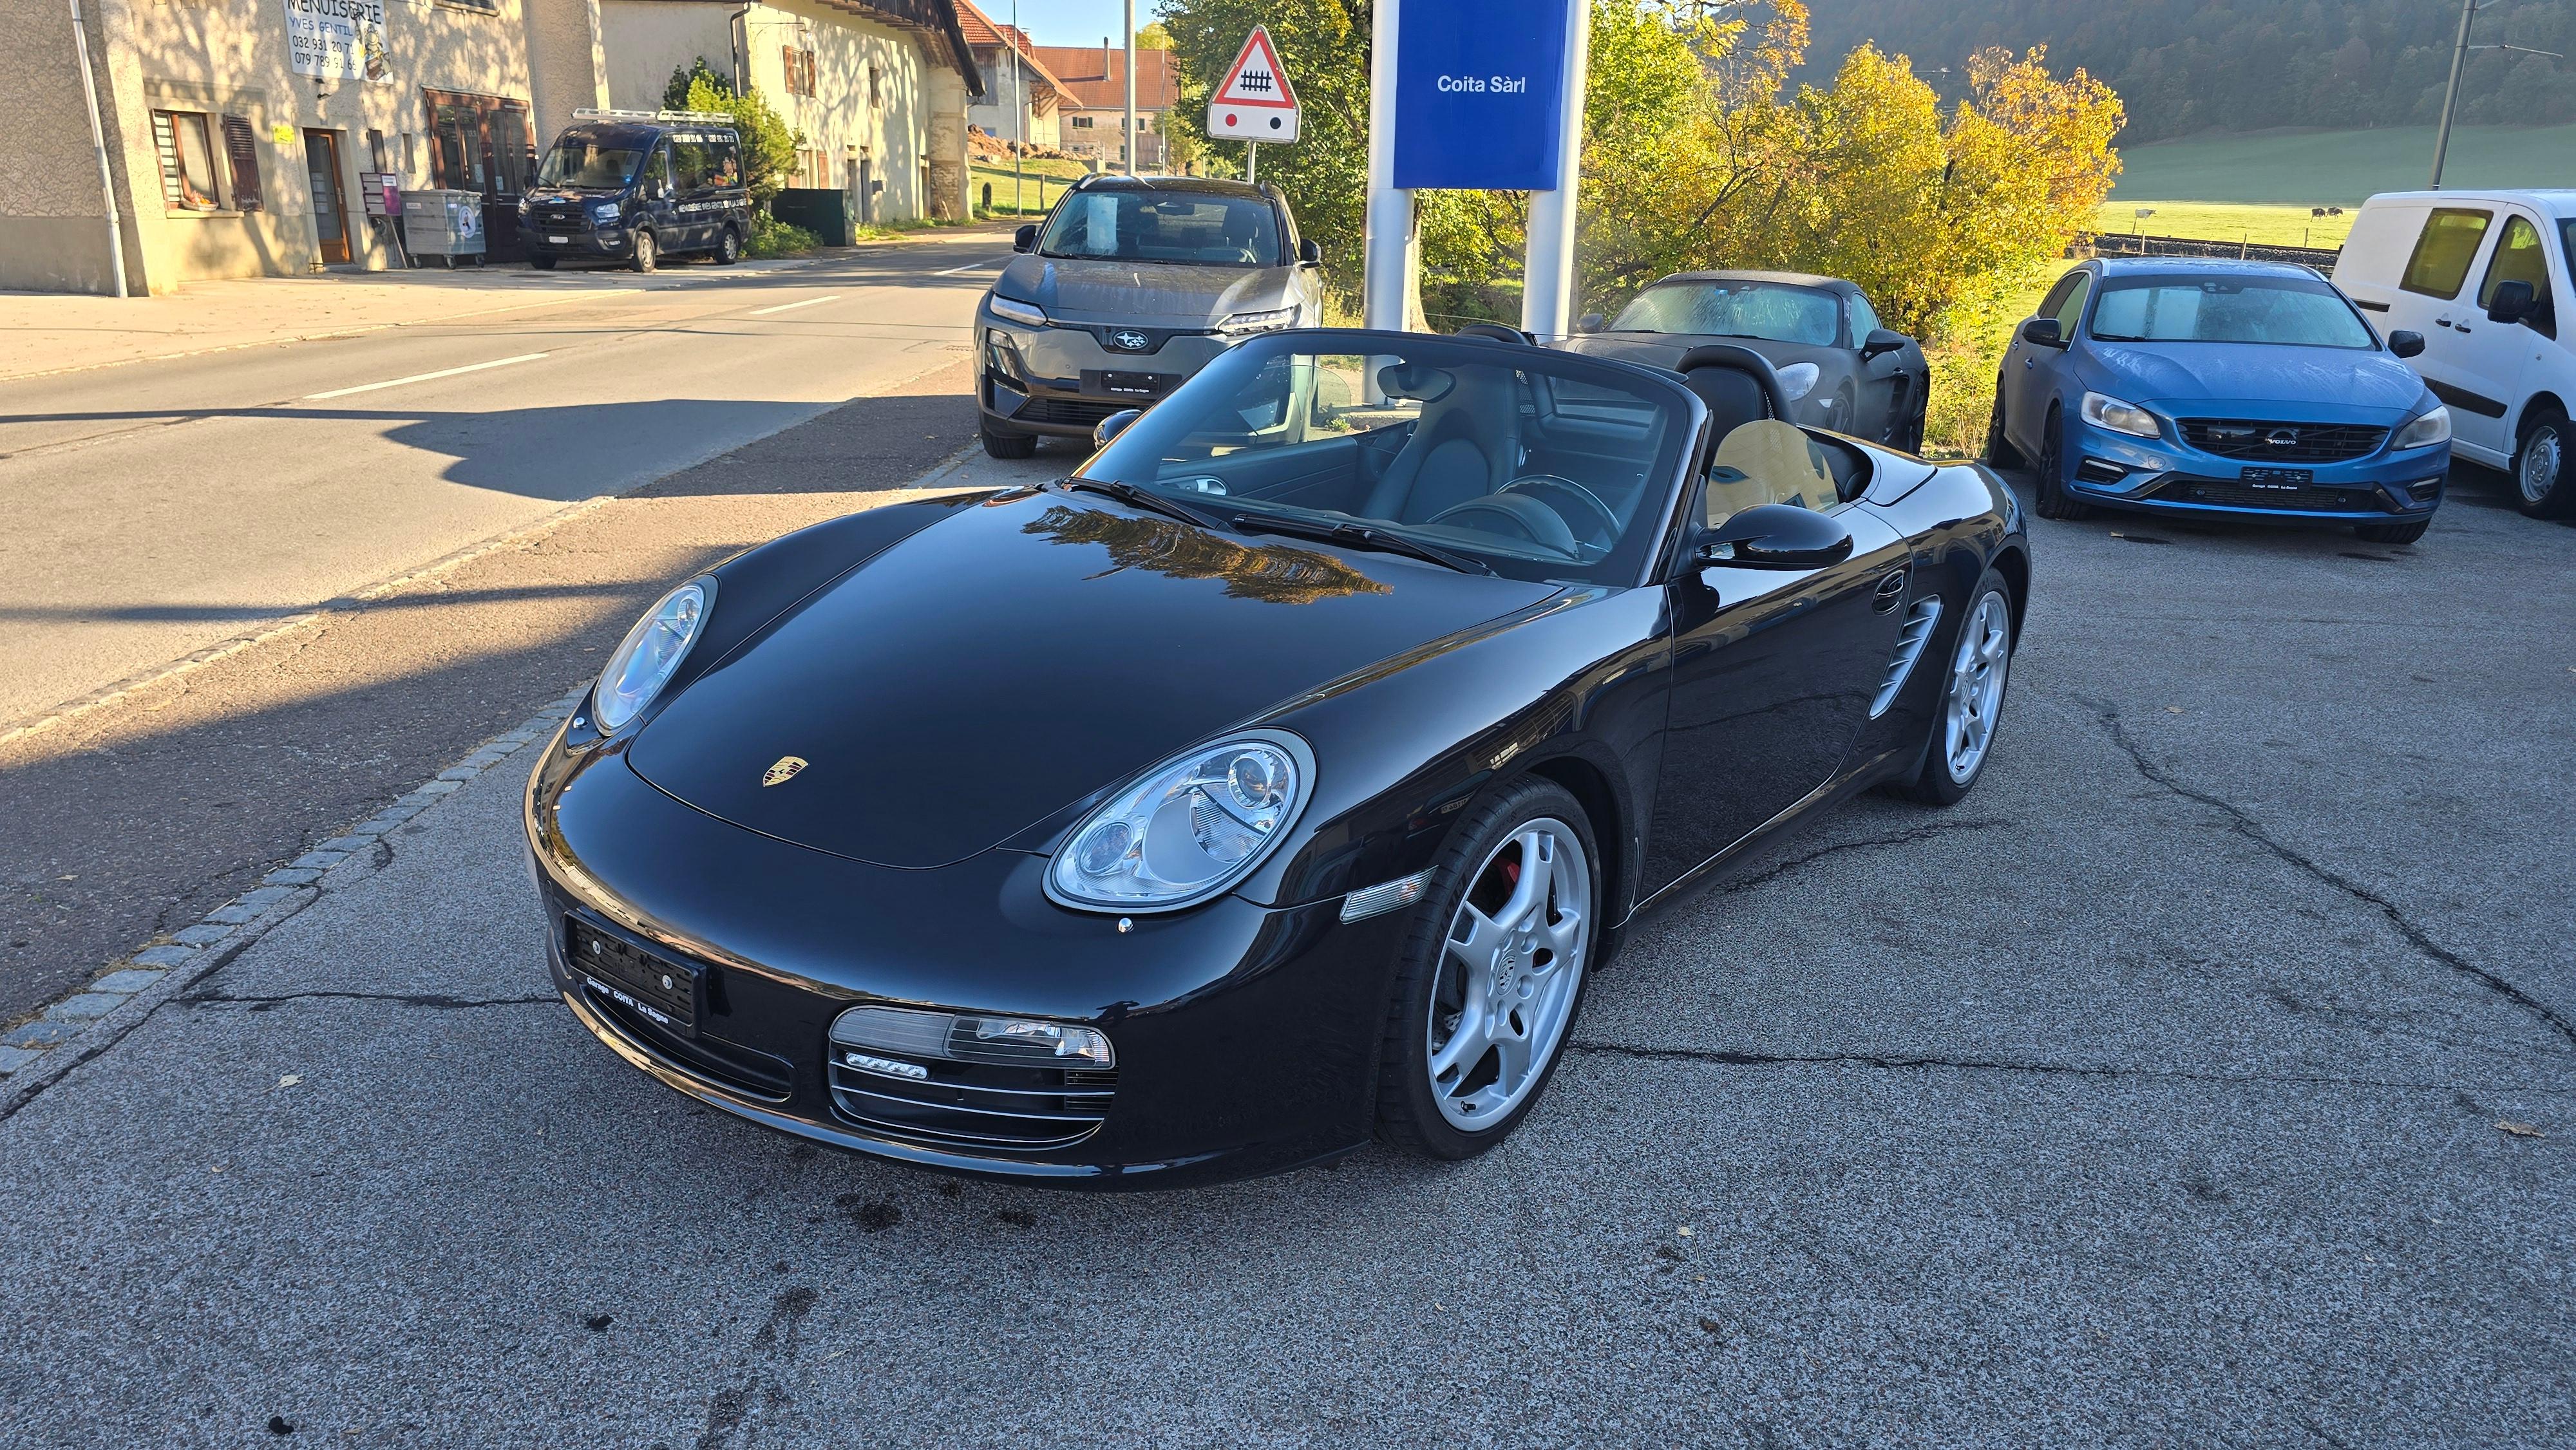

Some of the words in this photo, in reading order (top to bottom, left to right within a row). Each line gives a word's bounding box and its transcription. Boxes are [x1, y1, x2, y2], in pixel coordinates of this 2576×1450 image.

[289, 17, 314, 30] YVES
[319, 21, 353, 36] GENTIL
[292, 35, 309, 48] 032
[312, 39, 327, 51] 931
[332, 41, 342, 52] 20
[295, 52, 311, 65] 079
[314, 55, 330, 67] 789
[1437, 75, 1485, 92] Coita
[1490, 76, 1526, 93] Sàrl
[613, 990, 634, 1007] COITA
[638, 1003, 647, 1013] La
